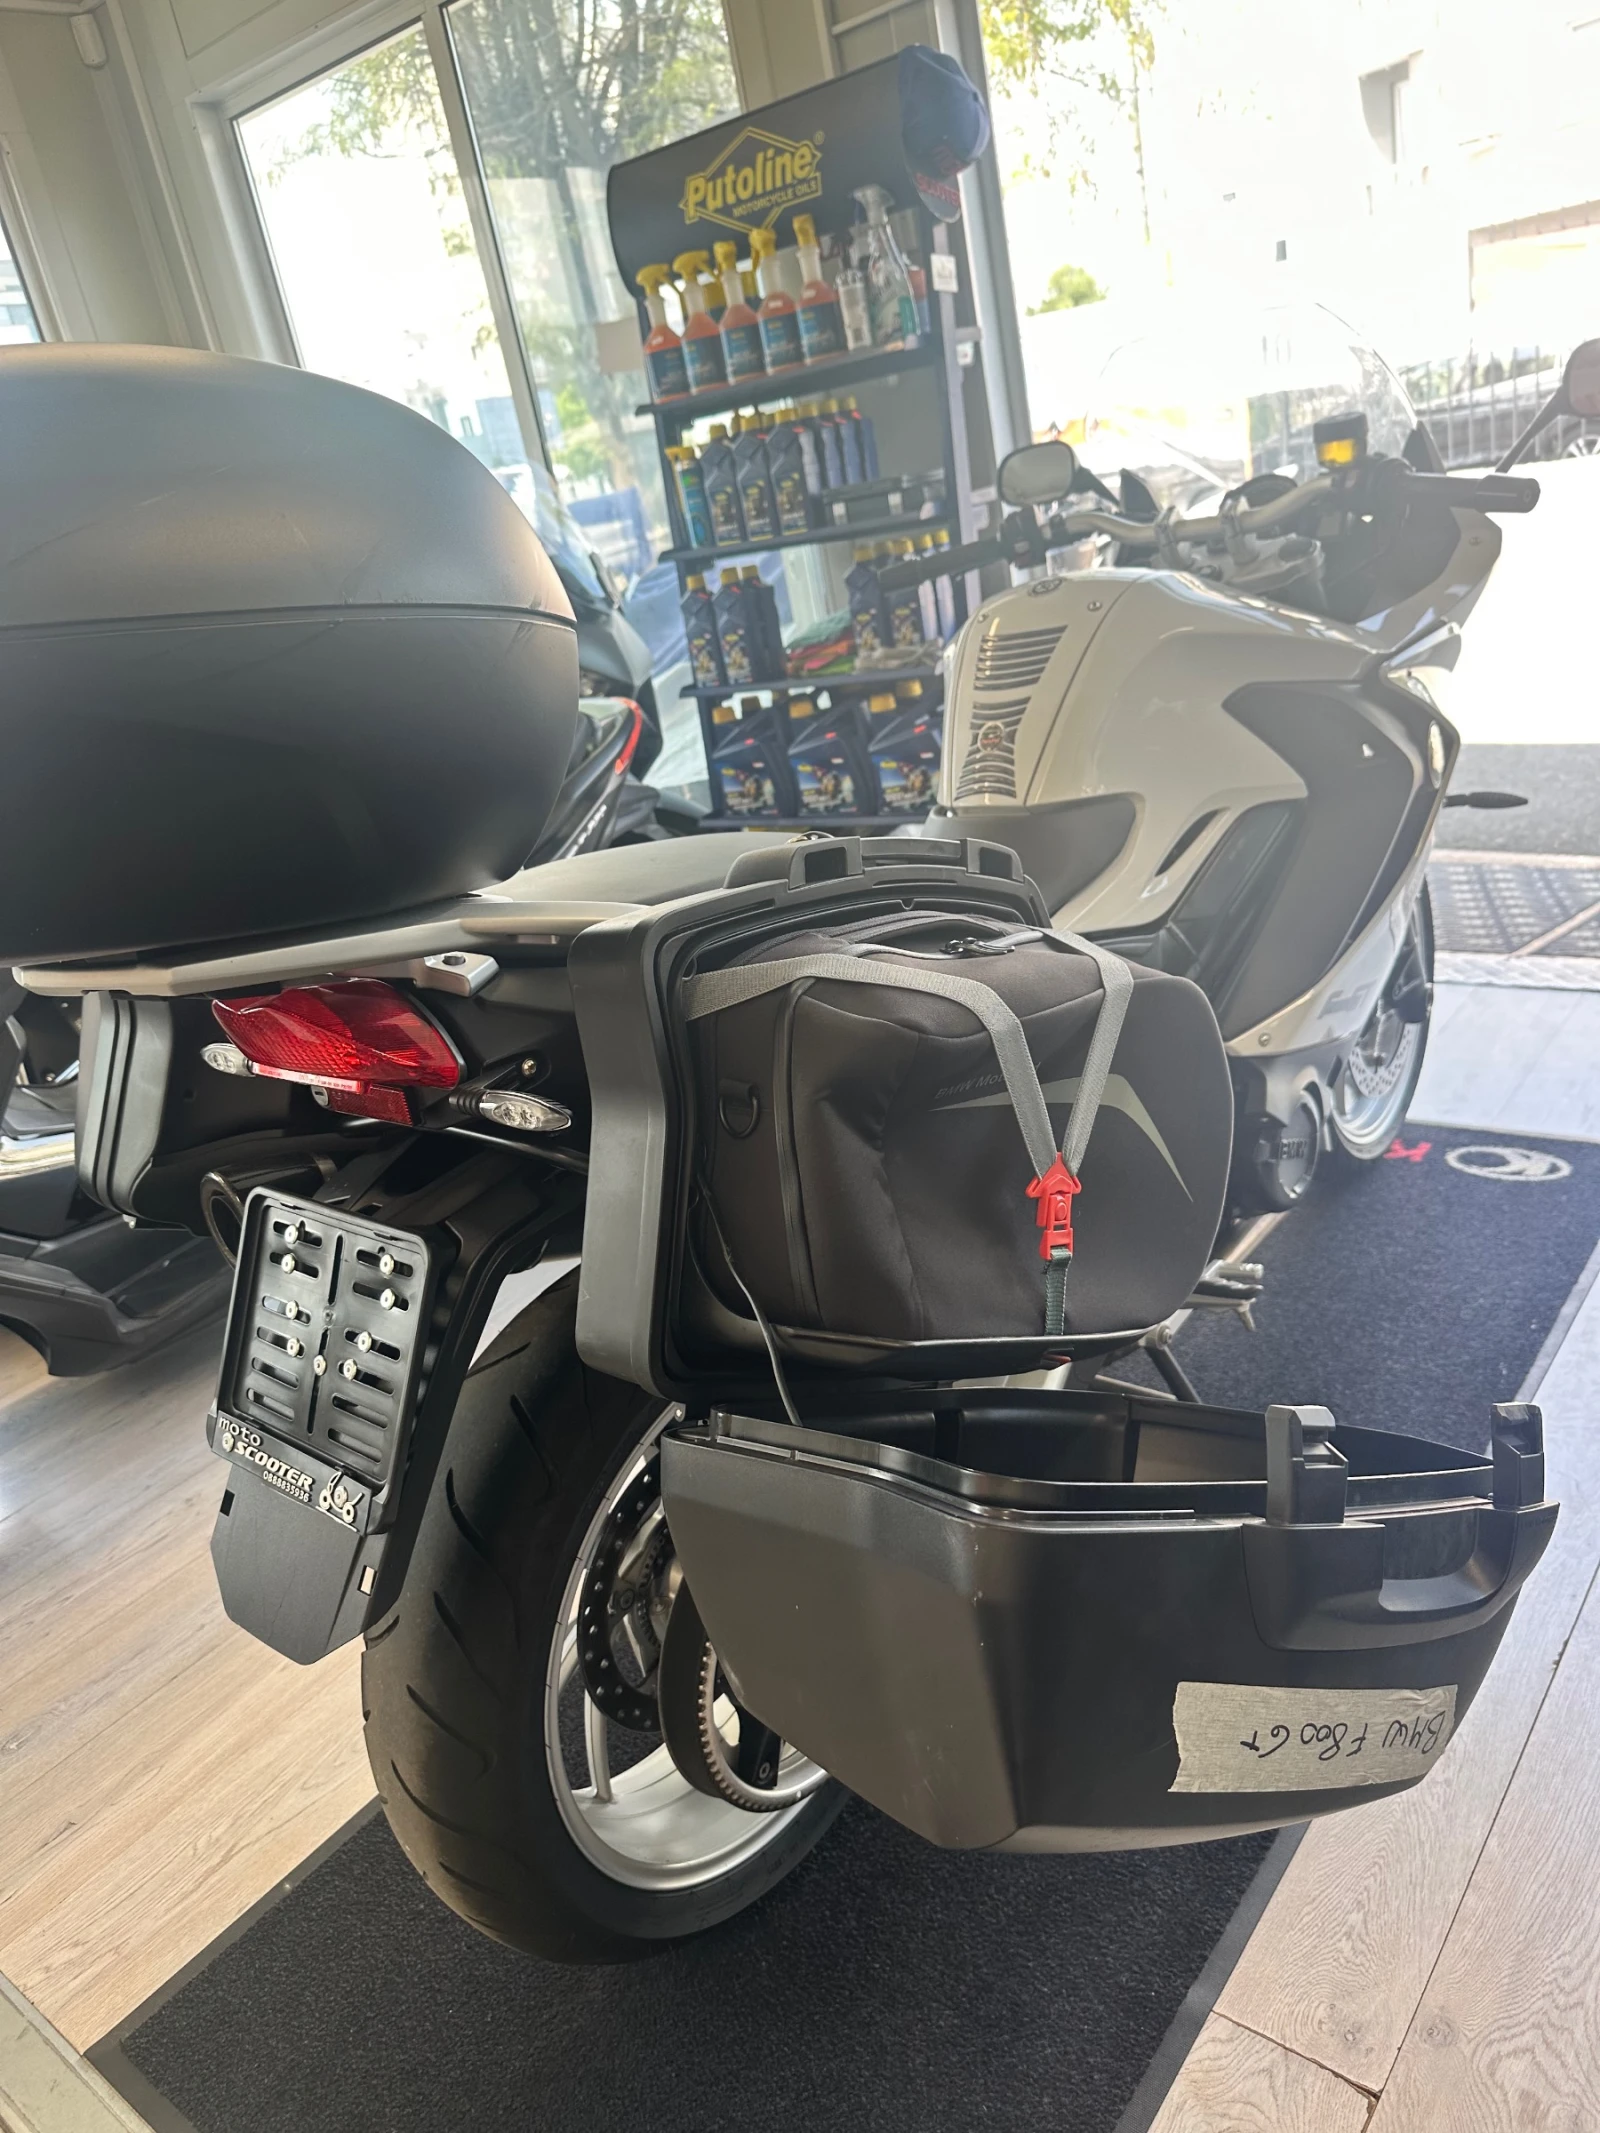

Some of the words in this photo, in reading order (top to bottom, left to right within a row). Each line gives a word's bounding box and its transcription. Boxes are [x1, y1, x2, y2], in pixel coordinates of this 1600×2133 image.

[687, 145, 813, 217] Putoline
[732, 188, 794, 218] MOTORCYCLE
[795, 179, 818, 197] OILS
[234, 1441, 313, 1491] SCOOTER
[262, 1470, 310, 1502] 0888835936
[1382, 1710, 1446, 1754] BMW
